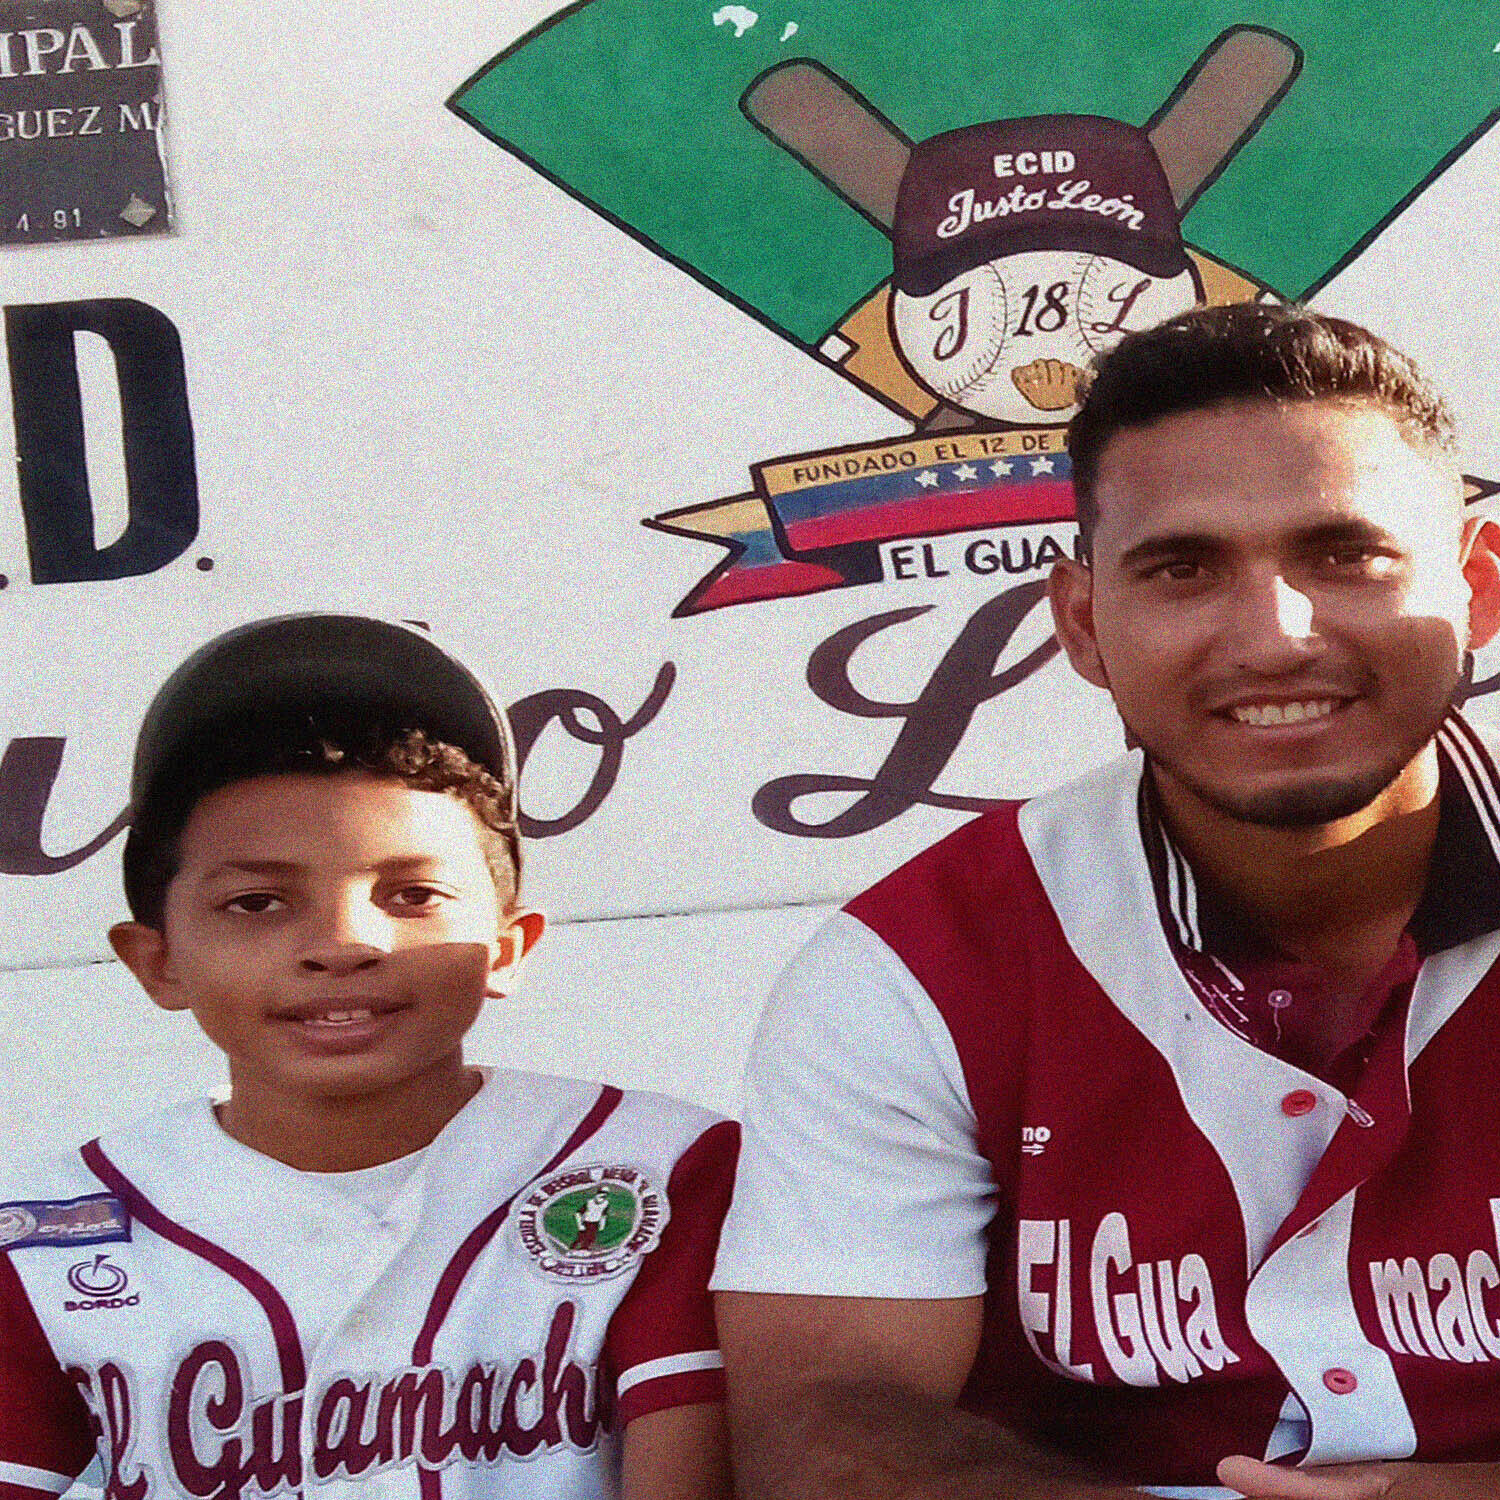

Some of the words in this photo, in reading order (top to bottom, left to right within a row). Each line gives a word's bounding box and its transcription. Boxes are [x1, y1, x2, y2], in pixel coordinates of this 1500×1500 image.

[993, 150, 1075, 178] ECID
[936, 188, 1044, 239] Justo
[1009, 280, 1069, 339] 18
[792, 449, 918, 484] FUNDADO
[935, 443, 967, 462] EL
[979, 436, 1006, 456] 12
[1021, 431, 1051, 452] DE
[890, 545, 957, 580] EL
